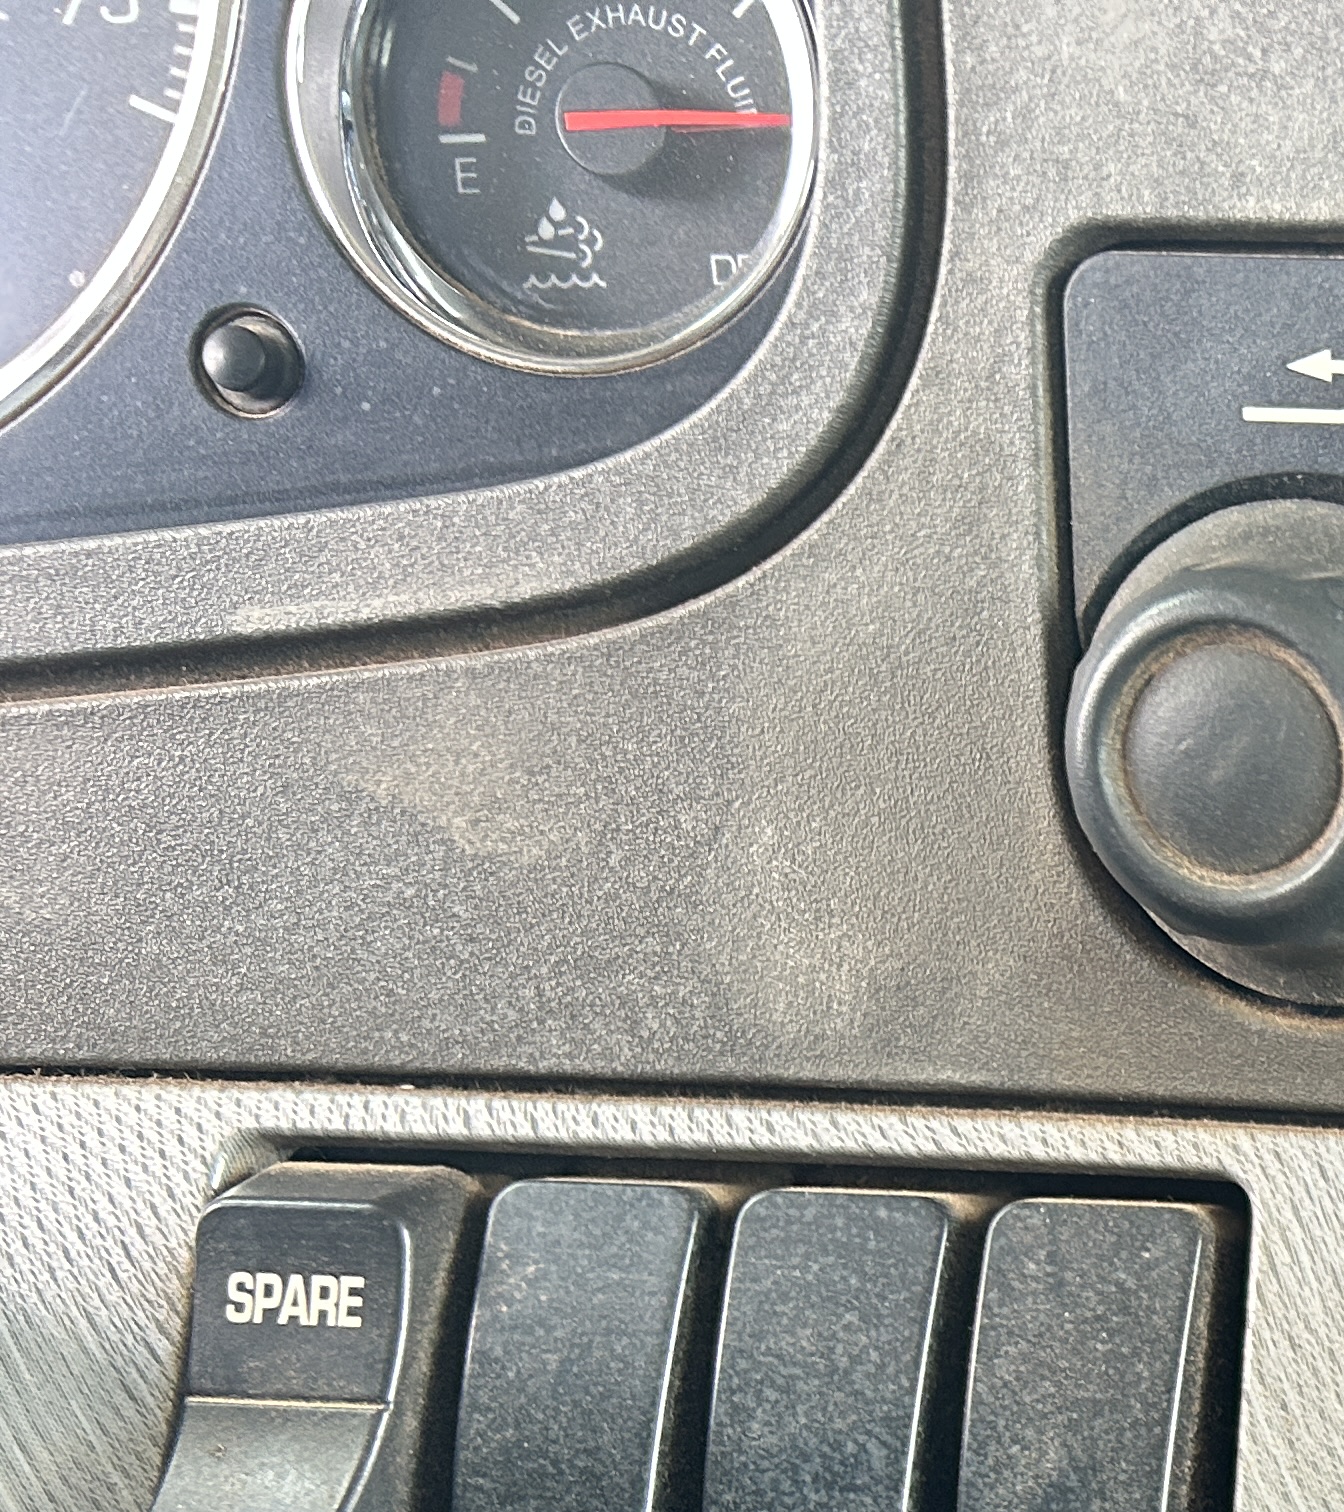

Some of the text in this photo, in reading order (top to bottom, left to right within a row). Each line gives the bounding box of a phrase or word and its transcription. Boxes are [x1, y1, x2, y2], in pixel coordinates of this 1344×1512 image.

[514, 2, 757, 135] DIESEL EXHAUST FLUI
[455, 157, 481, 193] E
[225, 1272, 366, 1330] SPARE
